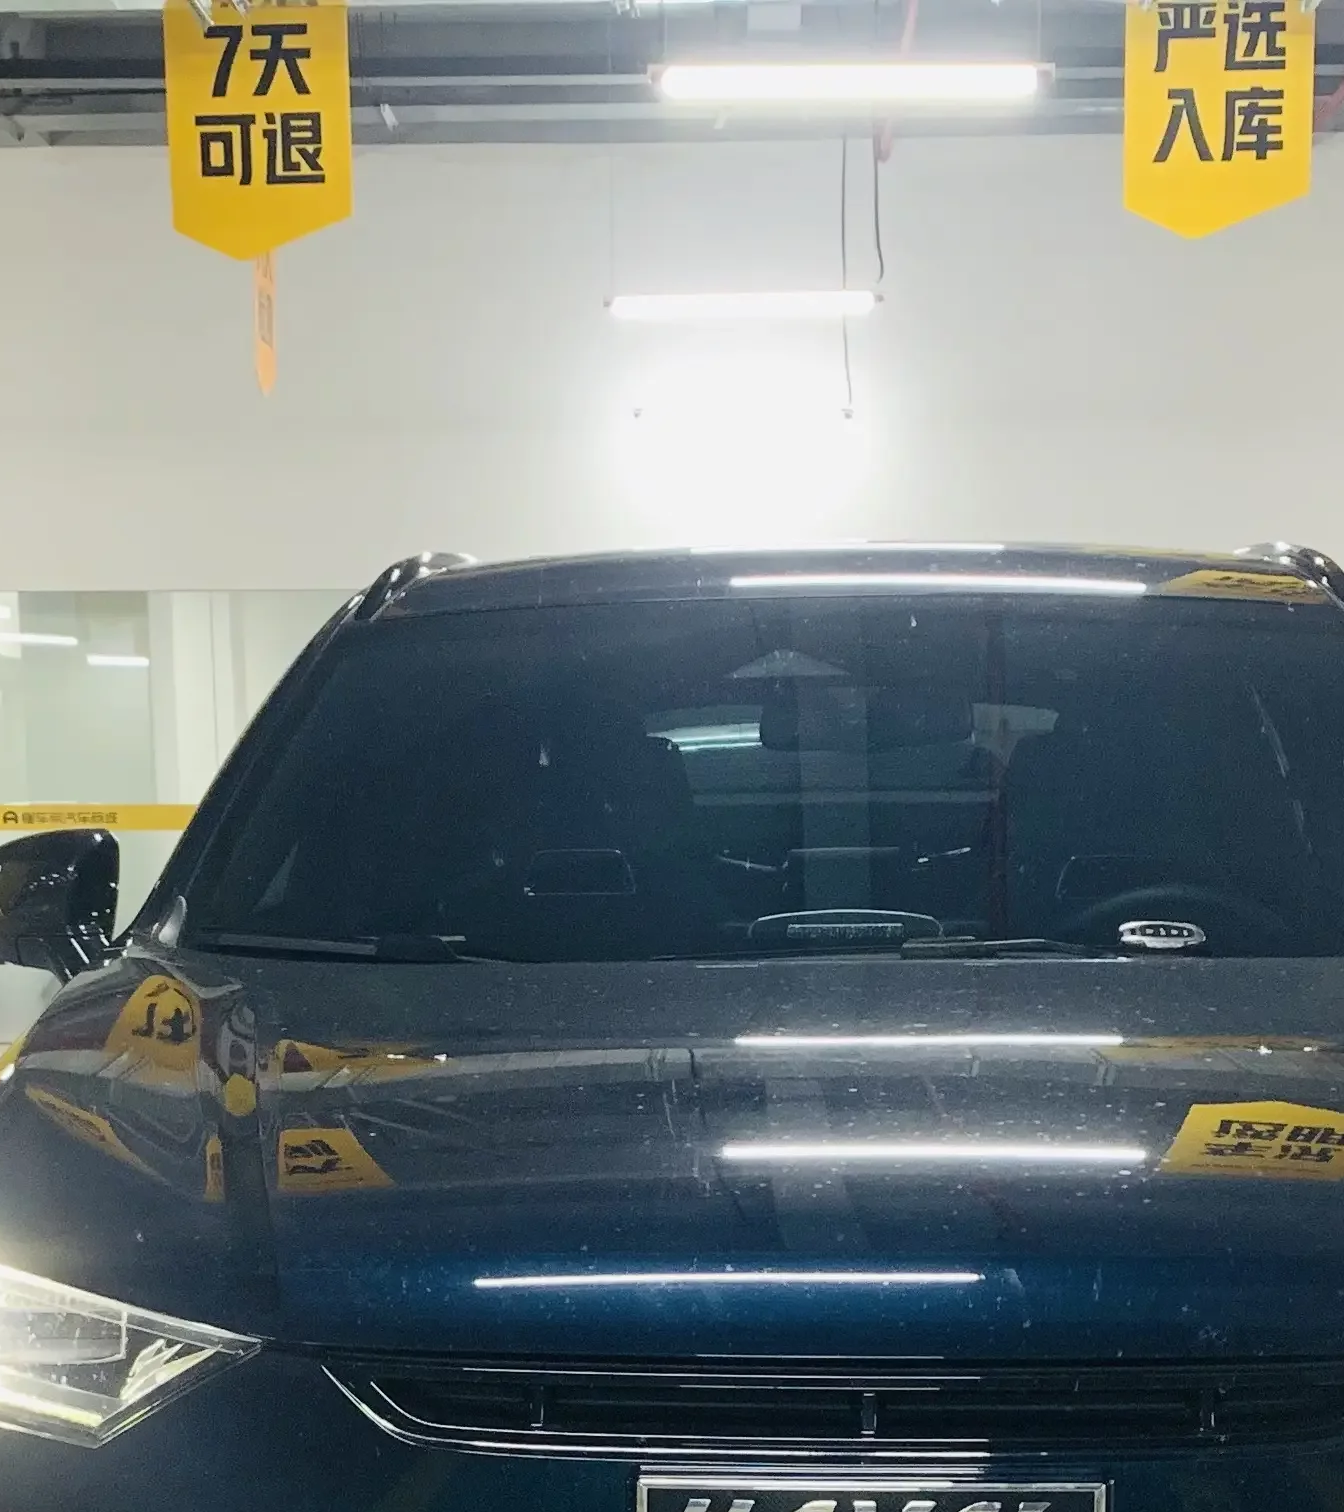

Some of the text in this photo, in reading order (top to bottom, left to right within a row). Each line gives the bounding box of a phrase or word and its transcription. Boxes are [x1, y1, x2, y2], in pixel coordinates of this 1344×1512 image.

[204, 24, 311, 97] 7天
[1154, 1, 1286, 72] 严选
[195, 112, 325, 185] 可退
[1153, 86, 1284, 163] 入库
